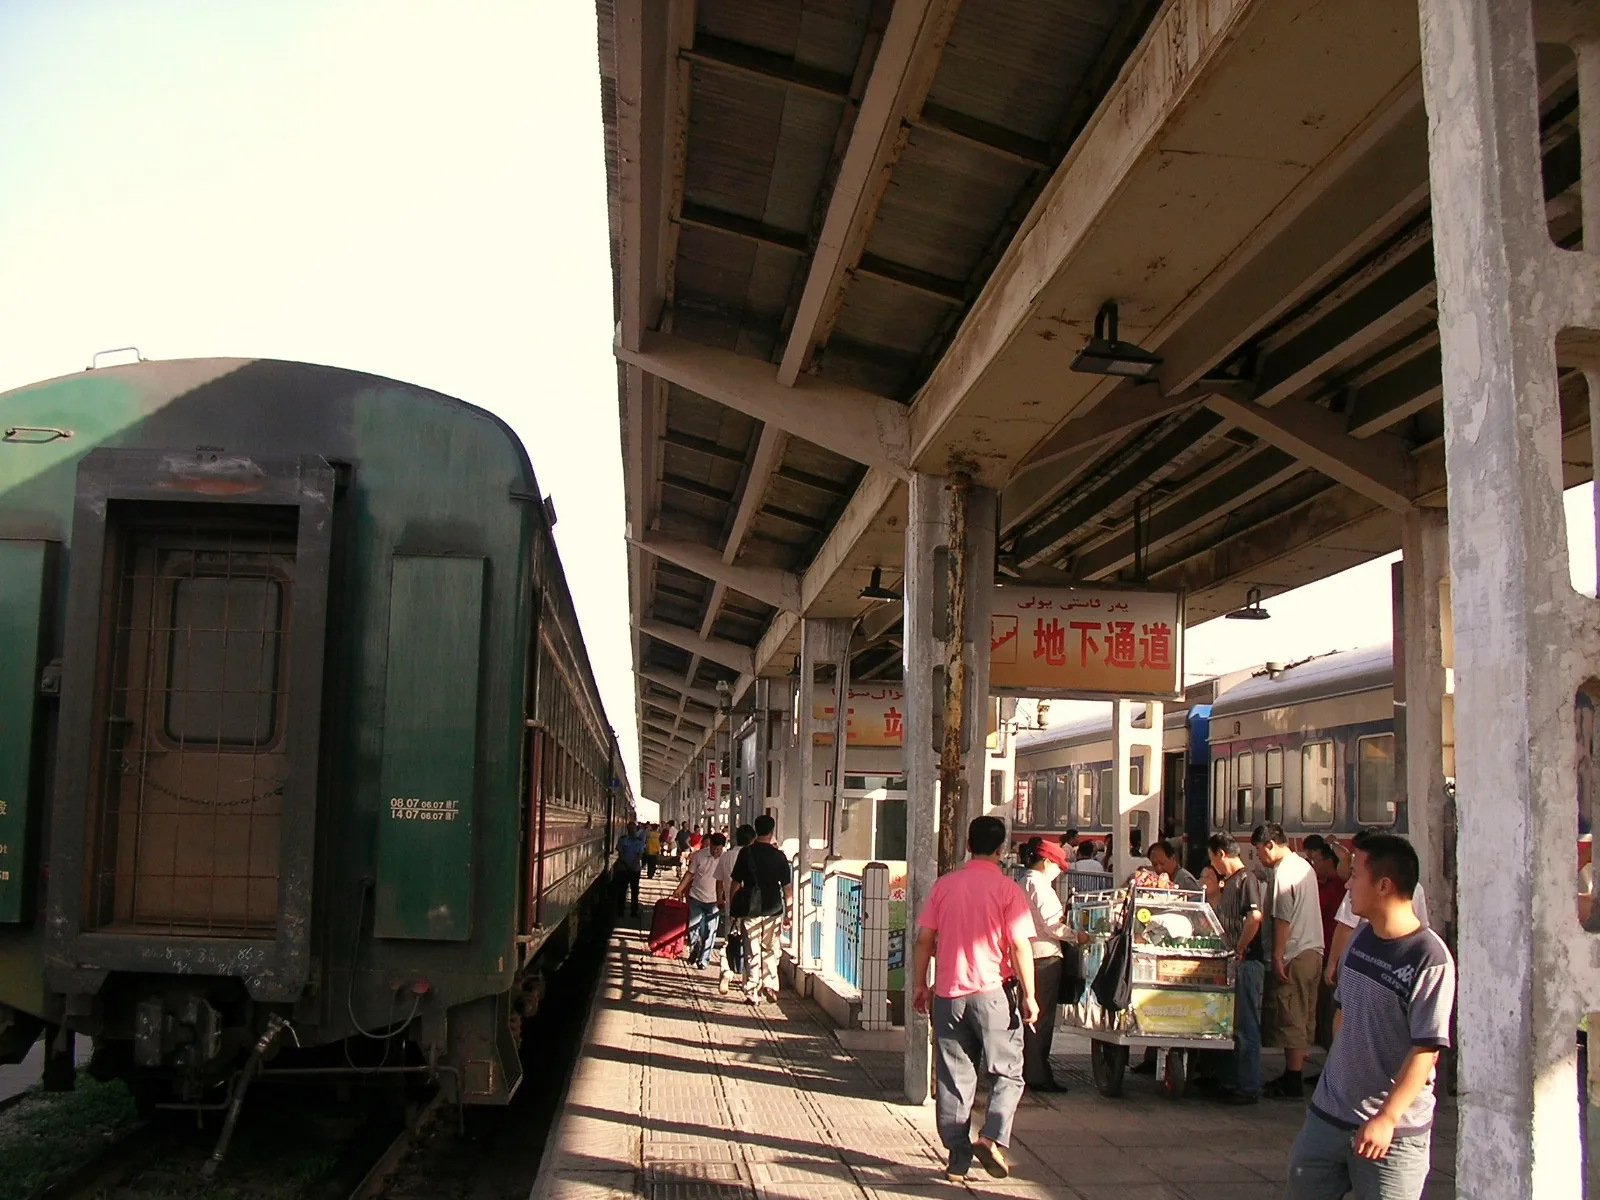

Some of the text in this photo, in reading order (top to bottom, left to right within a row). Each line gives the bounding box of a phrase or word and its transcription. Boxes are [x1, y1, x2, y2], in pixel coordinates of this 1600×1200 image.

[1033, 617, 1171, 670] 地下通道
[390, 798, 420, 808] 08.07
[421, 801, 444, 809] 06.07
[391, 810, 419, 819] 14.07
[420, 812, 444, 820] 06.07
